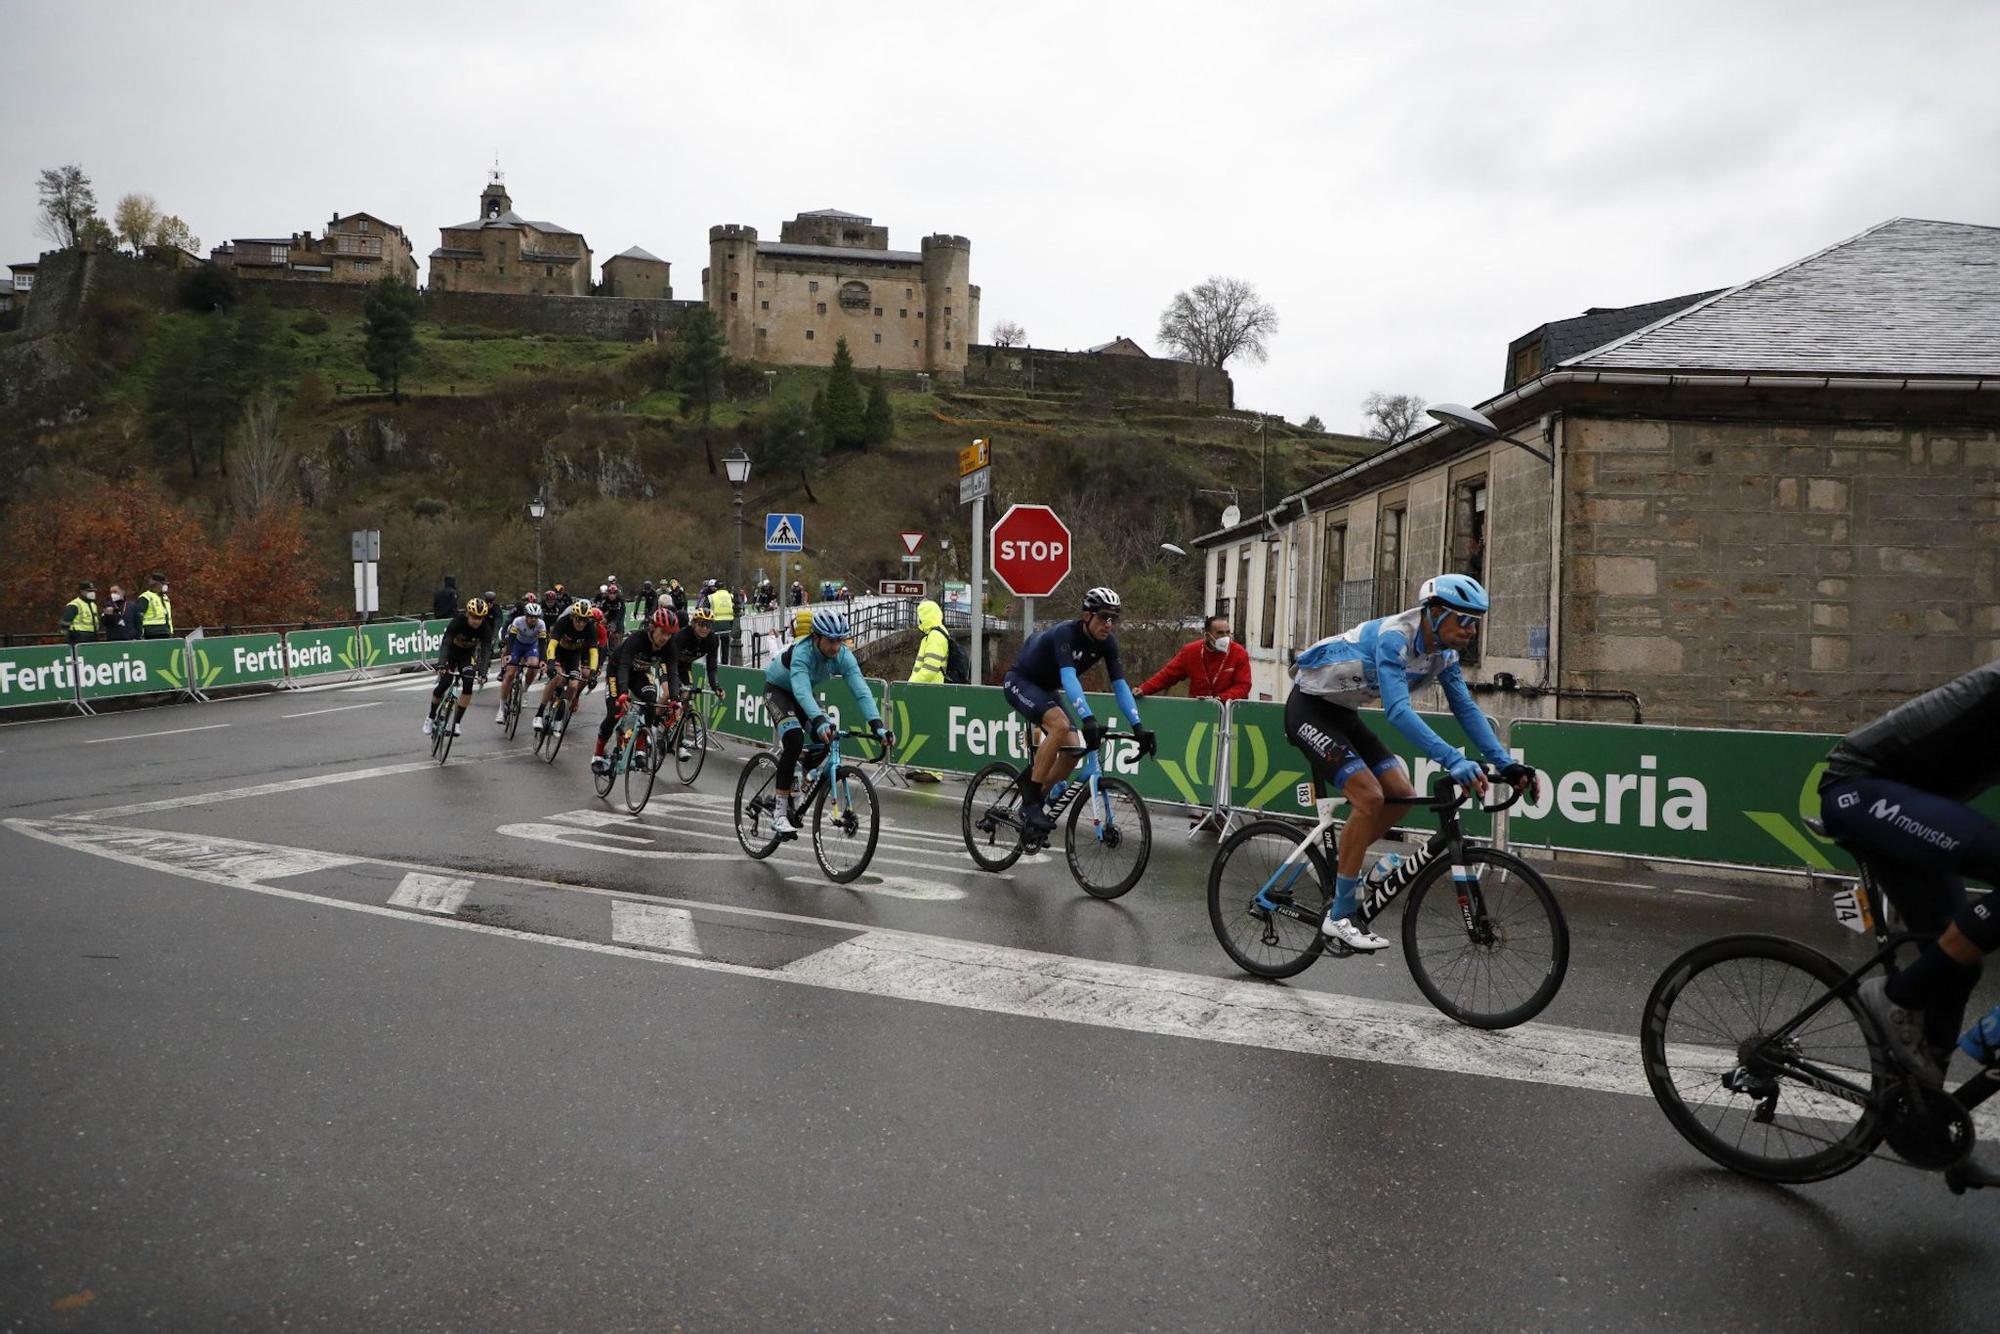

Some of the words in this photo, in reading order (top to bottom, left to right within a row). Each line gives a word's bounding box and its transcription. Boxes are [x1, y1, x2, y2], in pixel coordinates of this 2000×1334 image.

[1001, 541, 1063, 561] STOP
[0, 653, 147, 694] Fertiberia
[234, 640, 332, 674] Fertiberia
[1297, 723, 1332, 751] ISRAEL
[1048, 781, 1083, 822] ANYON
[1298, 785, 1309, 803] 183
[1895, 815, 1960, 850] movistar
[1361, 842, 1433, 919] FACTOR
[1833, 889, 1859, 922] 174
